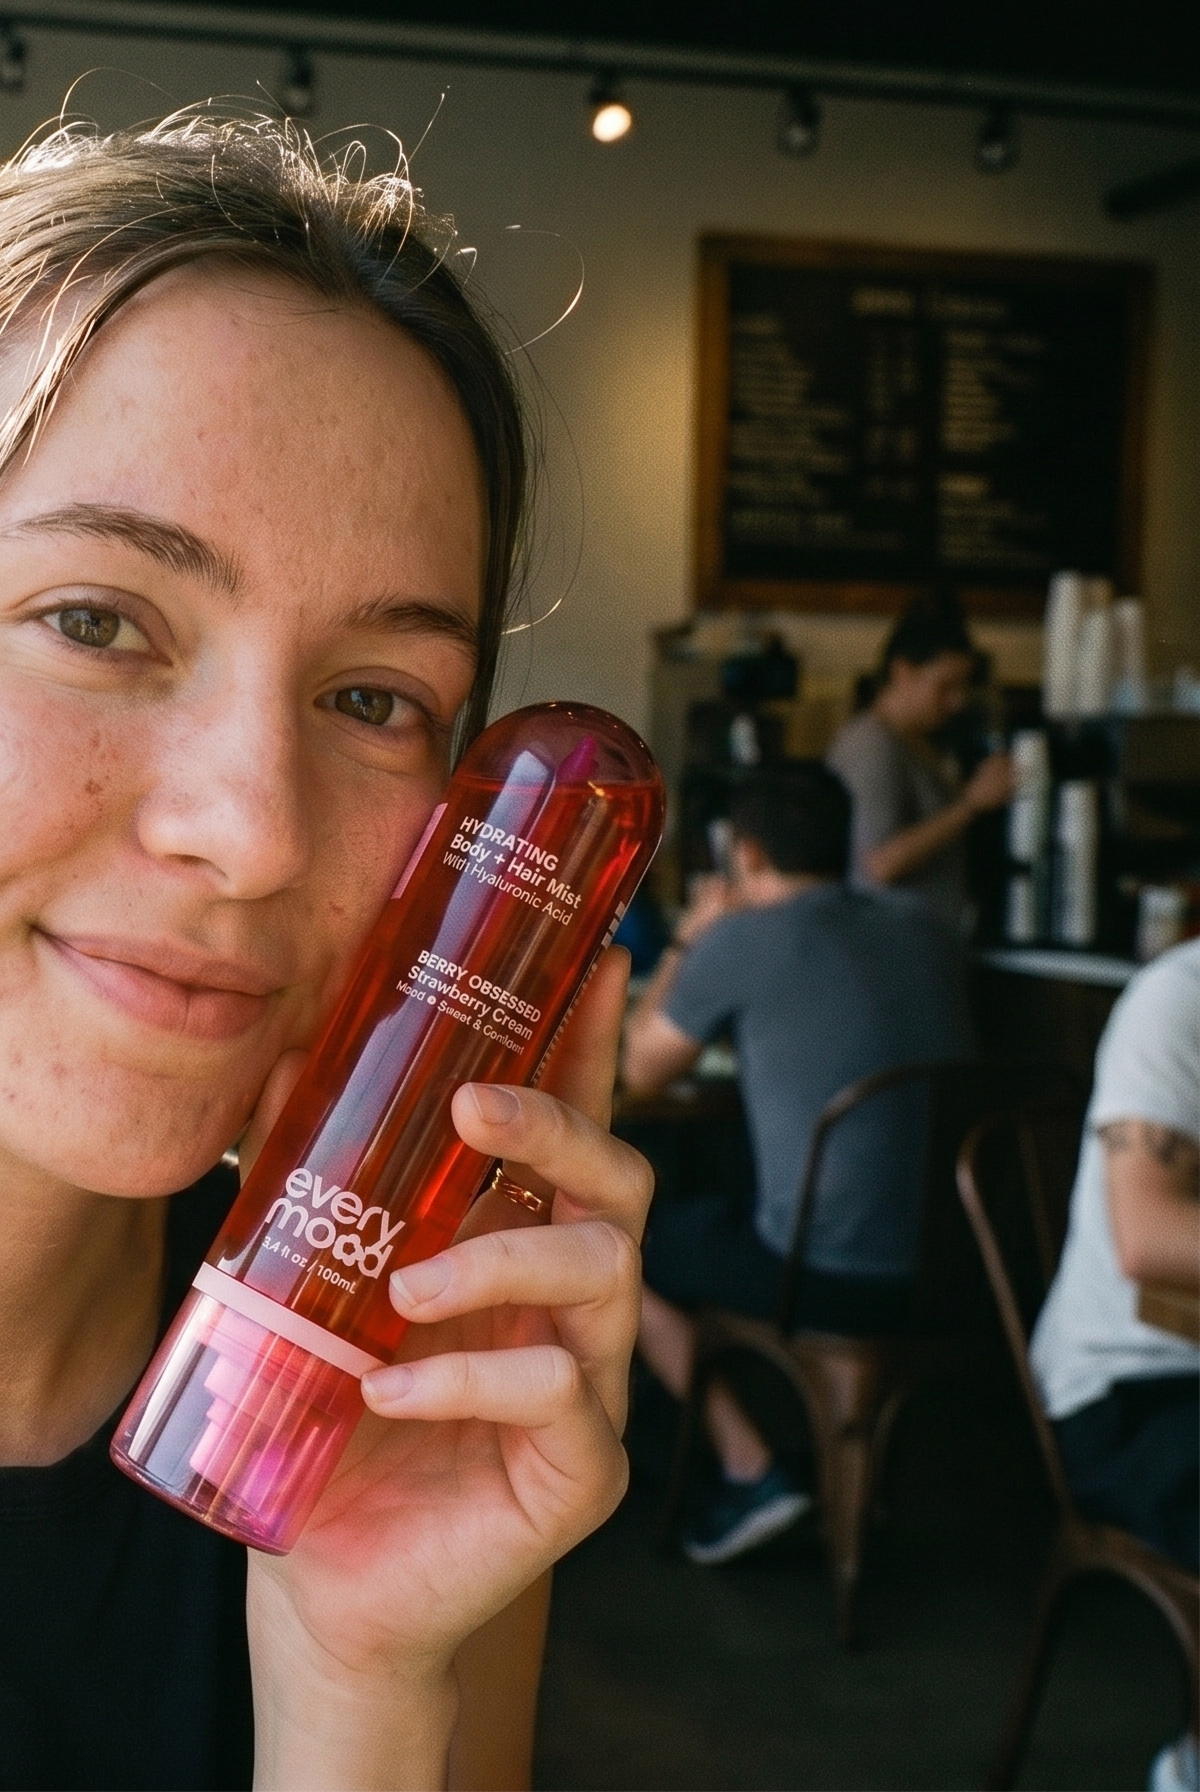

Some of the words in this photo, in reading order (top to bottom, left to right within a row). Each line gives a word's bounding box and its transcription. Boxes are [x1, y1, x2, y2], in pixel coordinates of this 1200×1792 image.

[450, 834, 492, 863] Body
[494, 853, 506, 864] +
[507, 857, 546, 886] Hair
[546, 878, 582, 909] Mist
[460, 816, 559, 871] HYDRATING
[442, 851, 471, 872] With
[470, 864, 542, 908] Hyaluronic
[542, 901, 573, 926] Acid
[396, 980, 426, 1001] Mood
[472, 1020, 482, 1031] &
[408, 965, 491, 1018] Strawberry
[492, 1008, 533, 1040] Cream
[417, 950, 468, 981] BERRY
[468, 975, 541, 1023] OBSESSED
[264, 1197, 394, 1279] mood
[285, 1167, 406, 1248] every
[262, 1236, 281, 1253] 3.4
[291, 1253, 308, 1268] oz
[317, 1264, 356, 1294] 100mL
